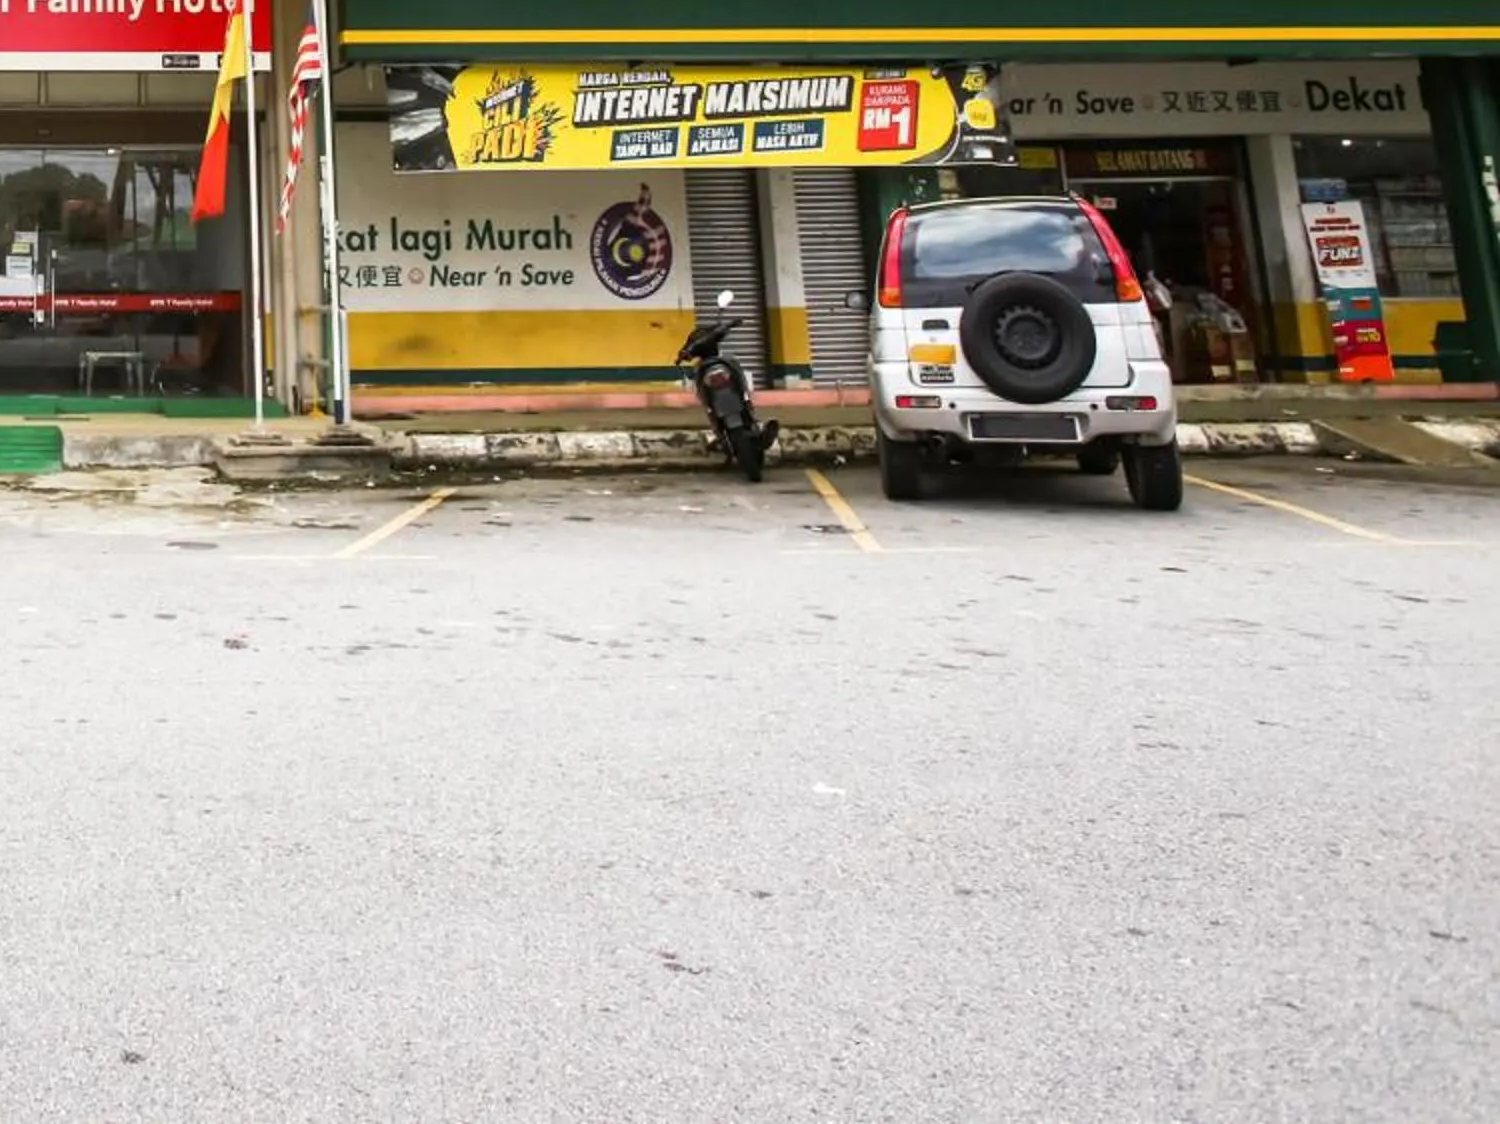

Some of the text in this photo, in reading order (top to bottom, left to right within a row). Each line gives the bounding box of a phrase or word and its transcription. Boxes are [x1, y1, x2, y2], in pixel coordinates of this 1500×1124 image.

[573, 77, 850, 124] INTERNET MAKSIMUM
[1010, 98, 1035, 115] ar
[1077, 90, 1134, 114] Save
[1161, 91, 1282, 113] 又近又便宜
[1305, 77, 1406, 112] Dekat
[620, 129, 672, 143] INTERNET
[698, 126, 735, 139] SEMUA
[773, 122, 805, 135] LEBIH
[391, 216, 451, 261] lagi
[465, 215, 573, 251] Murah
[430, 265, 487, 287] Near
[521, 263, 574, 286] Save
